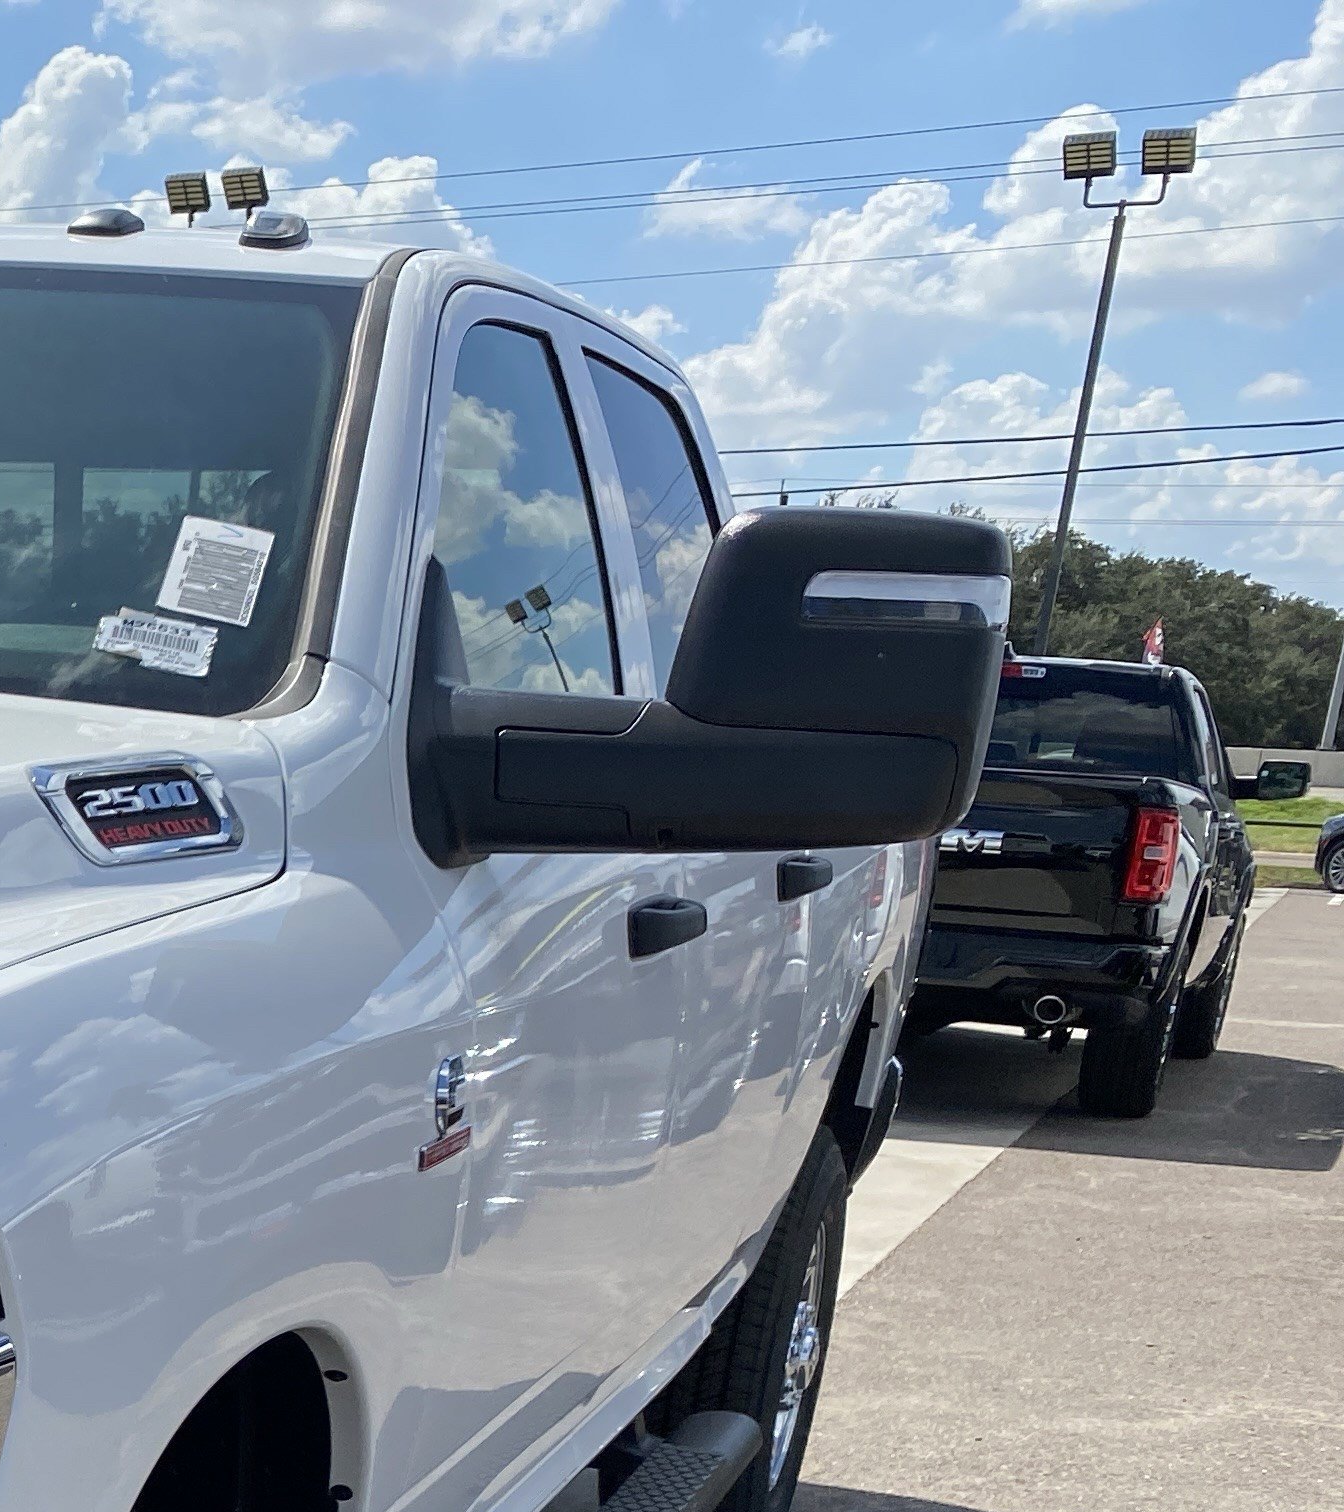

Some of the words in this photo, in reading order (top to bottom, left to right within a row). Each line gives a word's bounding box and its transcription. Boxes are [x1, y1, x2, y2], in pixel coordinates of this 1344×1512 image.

[77, 779, 200, 819] 2500
[97, 822, 164, 844] HEAVY
[164, 817, 211, 836] DUTY
